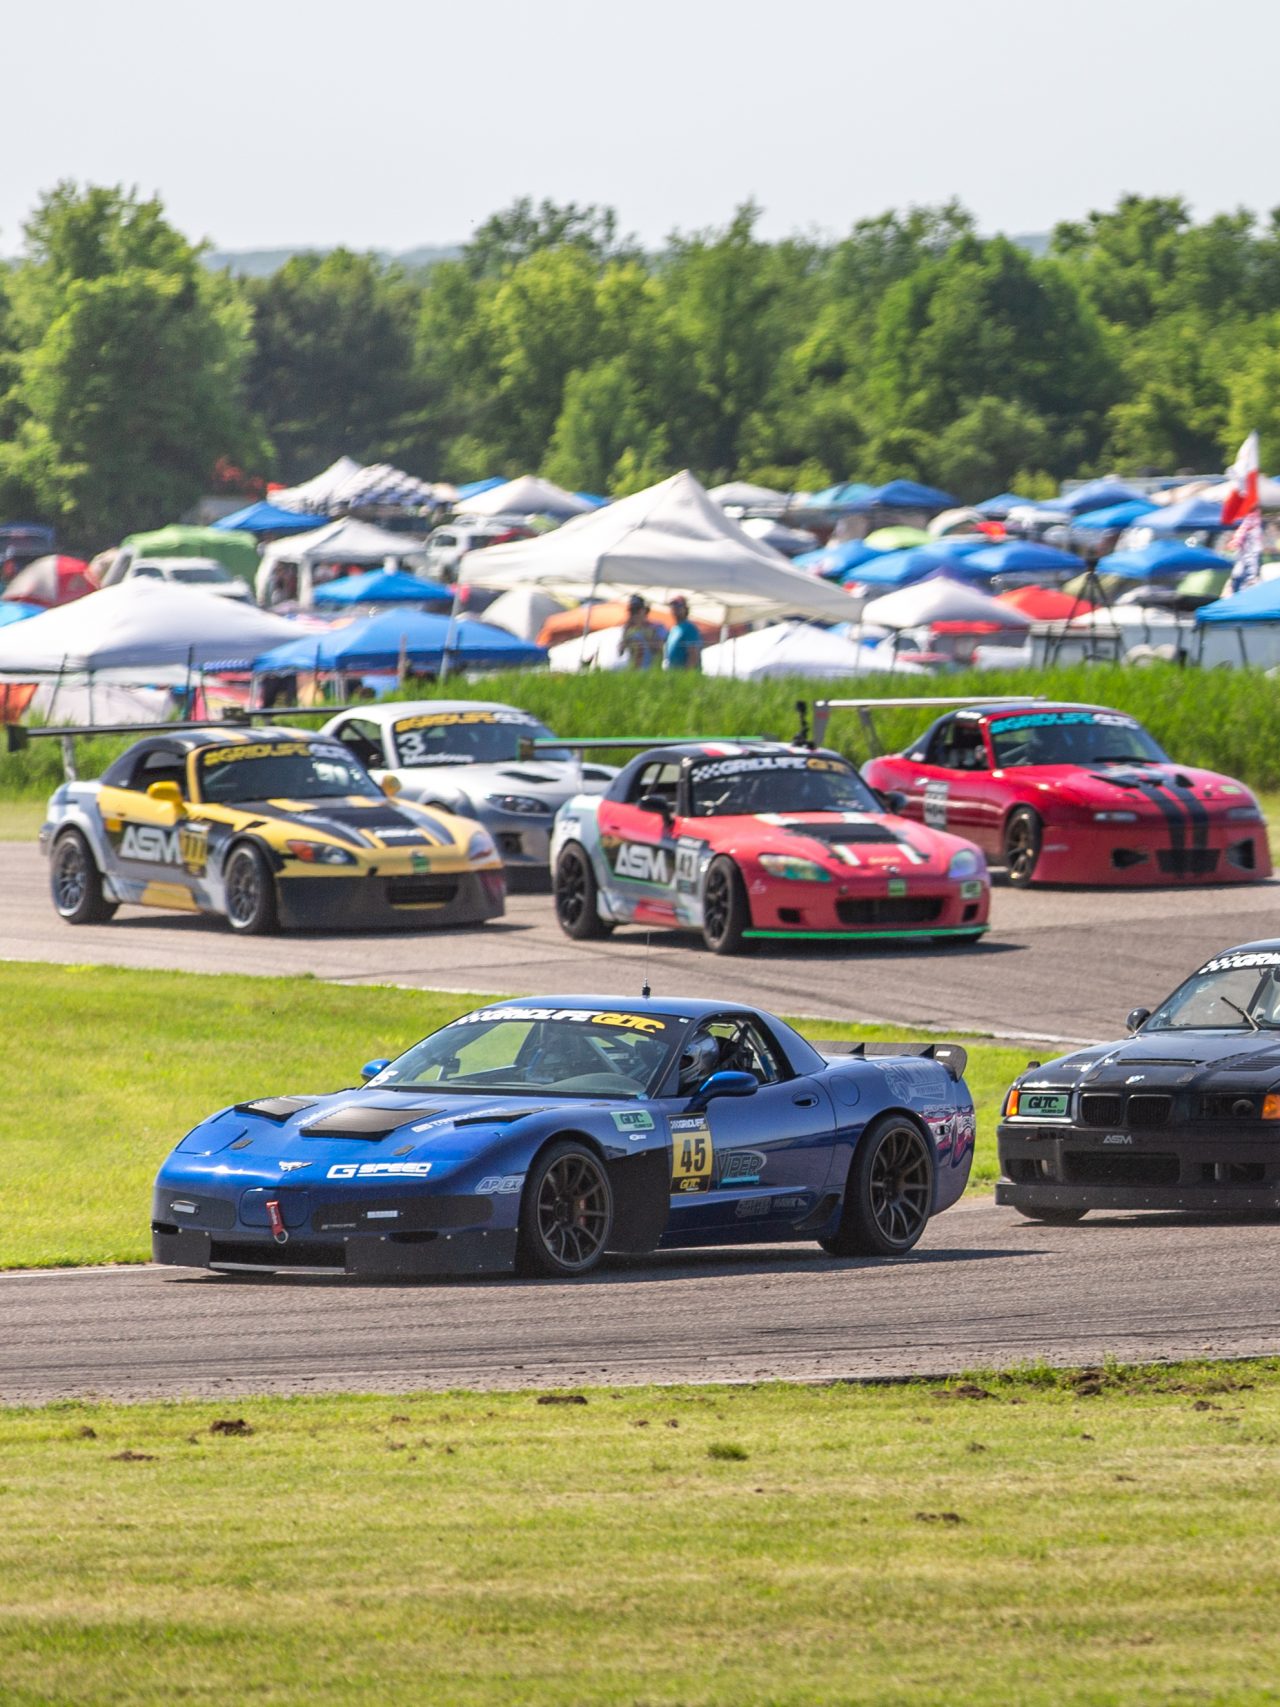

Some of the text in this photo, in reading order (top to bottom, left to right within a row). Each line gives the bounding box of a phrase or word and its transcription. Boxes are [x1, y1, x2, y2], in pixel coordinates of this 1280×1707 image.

[397, 732, 426, 757] 3
[718, 757, 807, 775] GRIDLIFE
[119, 825, 183, 864] ASM
[614, 842, 669, 883] ASM
[483, 1008, 666, 1033] GRIDLIFE GLTC
[1028, 1096, 1059, 1109] GLTC
[1103, 1135, 1133, 1145] ASM
[681, 1138, 706, 1174] 45
[717, 1151, 762, 1184] VIPER
[326, 1162, 433, 1178] G SPEED
